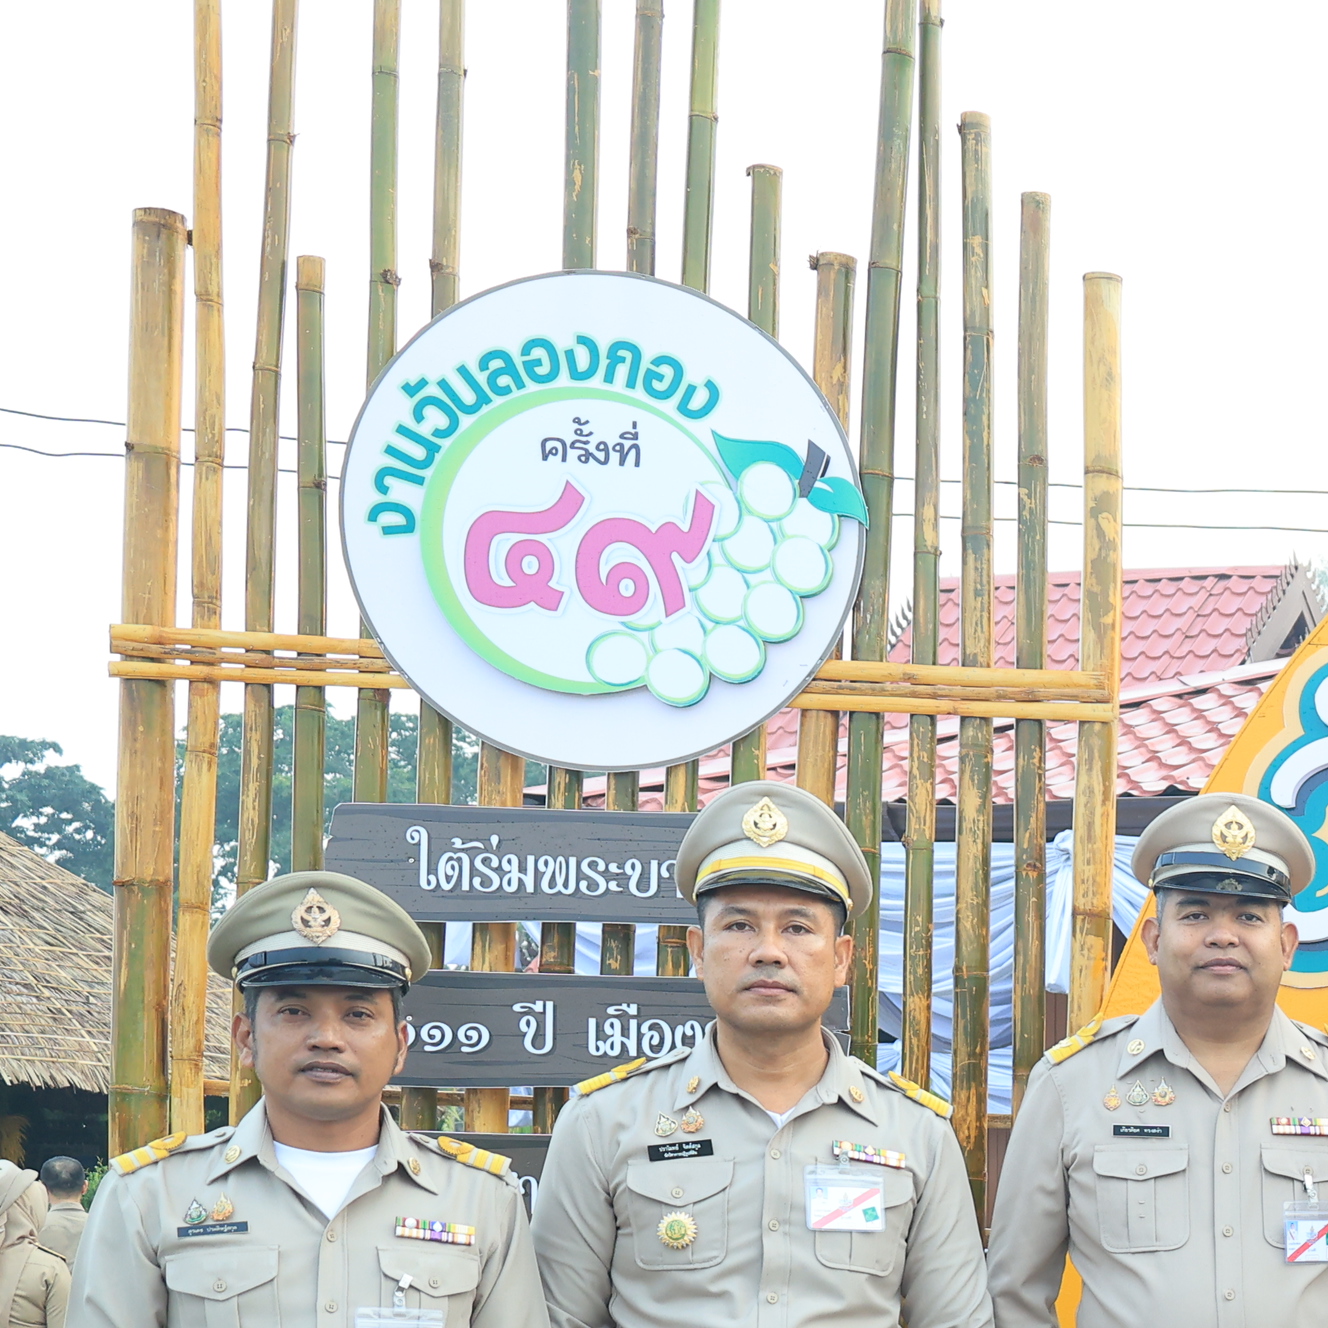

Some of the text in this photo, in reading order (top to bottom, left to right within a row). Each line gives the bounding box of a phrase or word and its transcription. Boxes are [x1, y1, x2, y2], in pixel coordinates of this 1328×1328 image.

[365, 332, 721, 537] งานวันลองกอง
[540, 417, 642, 469] ครั้งที่
[511, 1000, 553, 1055] ปี
